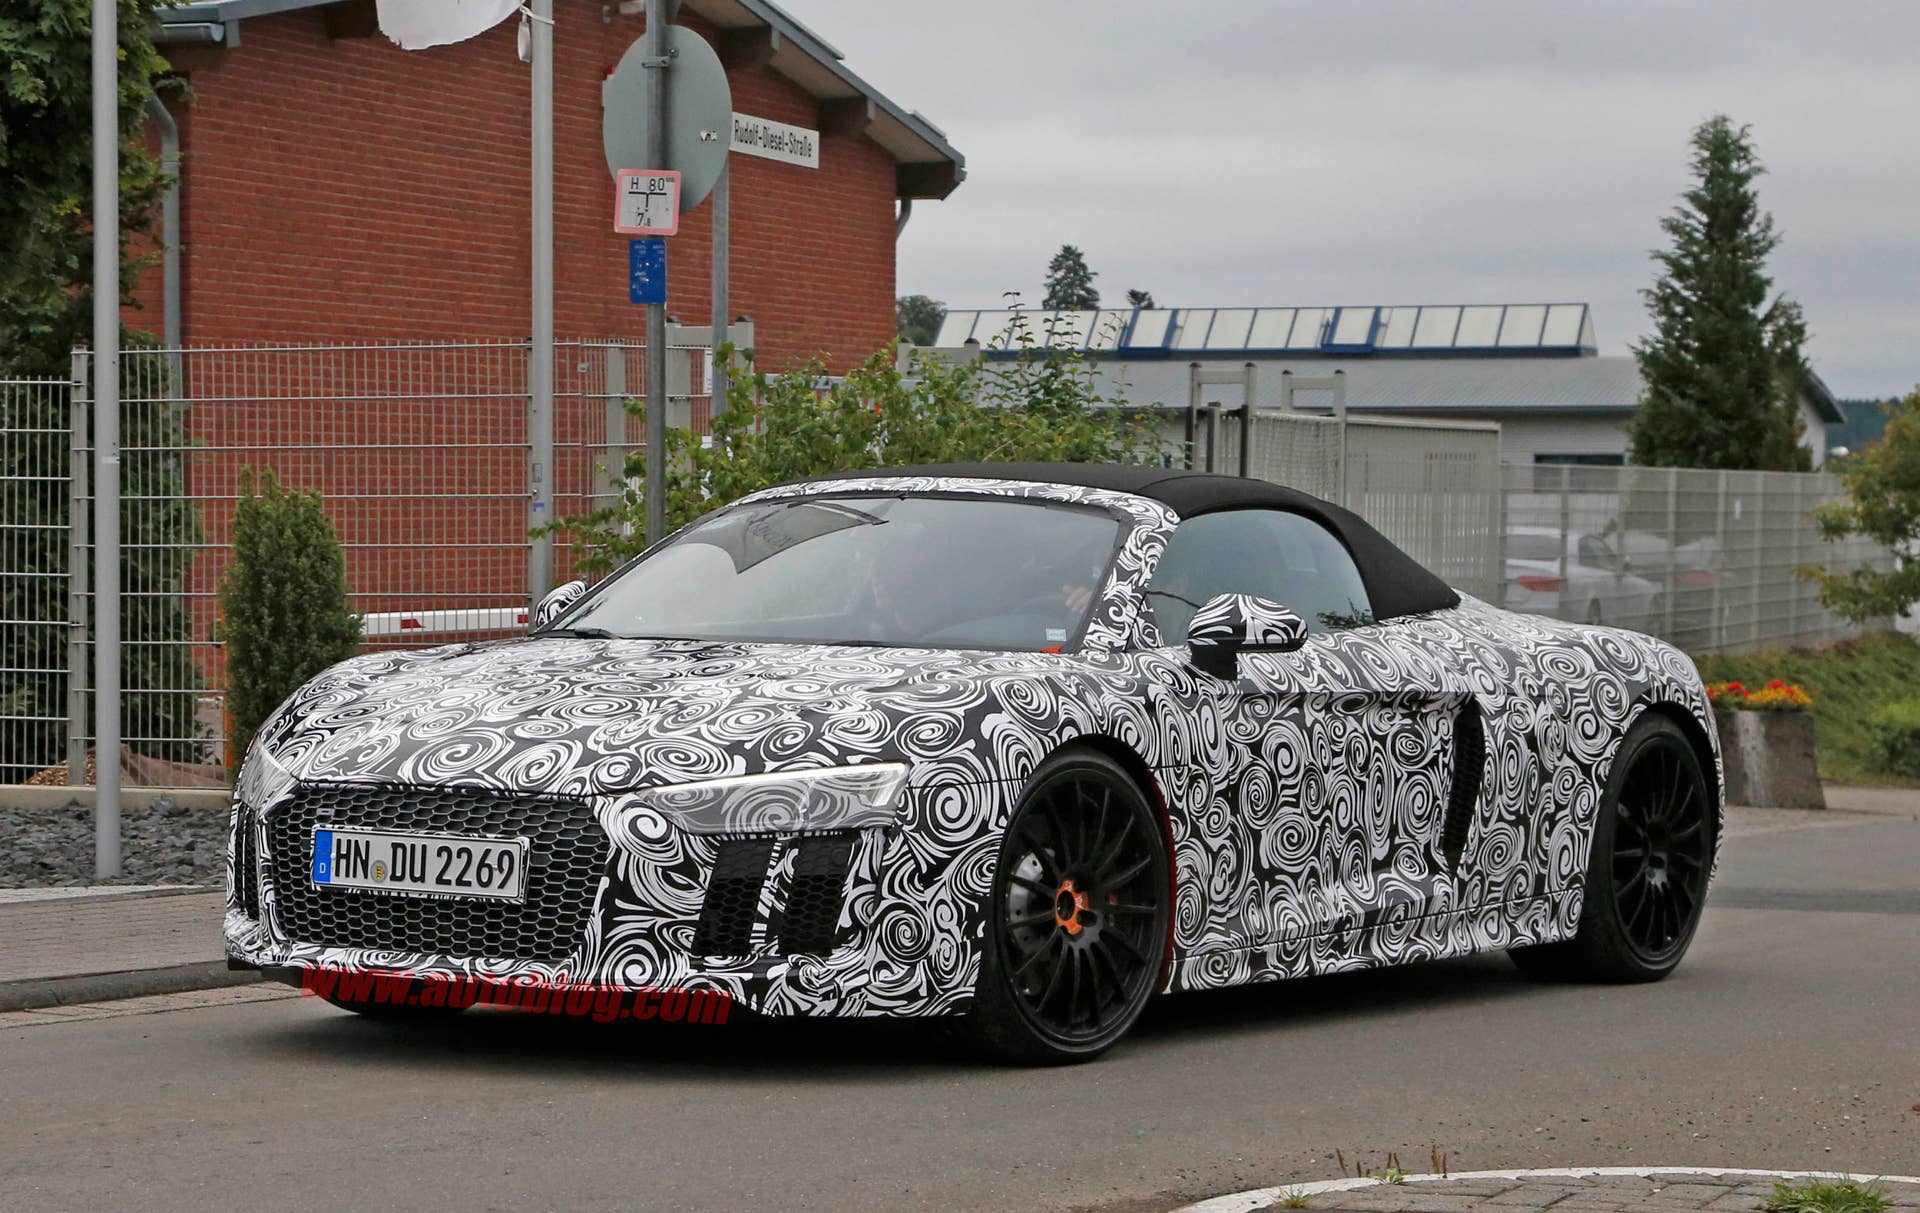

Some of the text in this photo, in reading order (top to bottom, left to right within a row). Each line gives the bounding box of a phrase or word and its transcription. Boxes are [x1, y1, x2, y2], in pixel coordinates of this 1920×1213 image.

[734, 119, 813, 158] Rudolf-Diesel-Straße
[630, 176, 639, 190] H
[649, 177, 665, 192] 80
[318, 862, 327, 875] D
[334, 838, 516, 890] HN DU 2269
